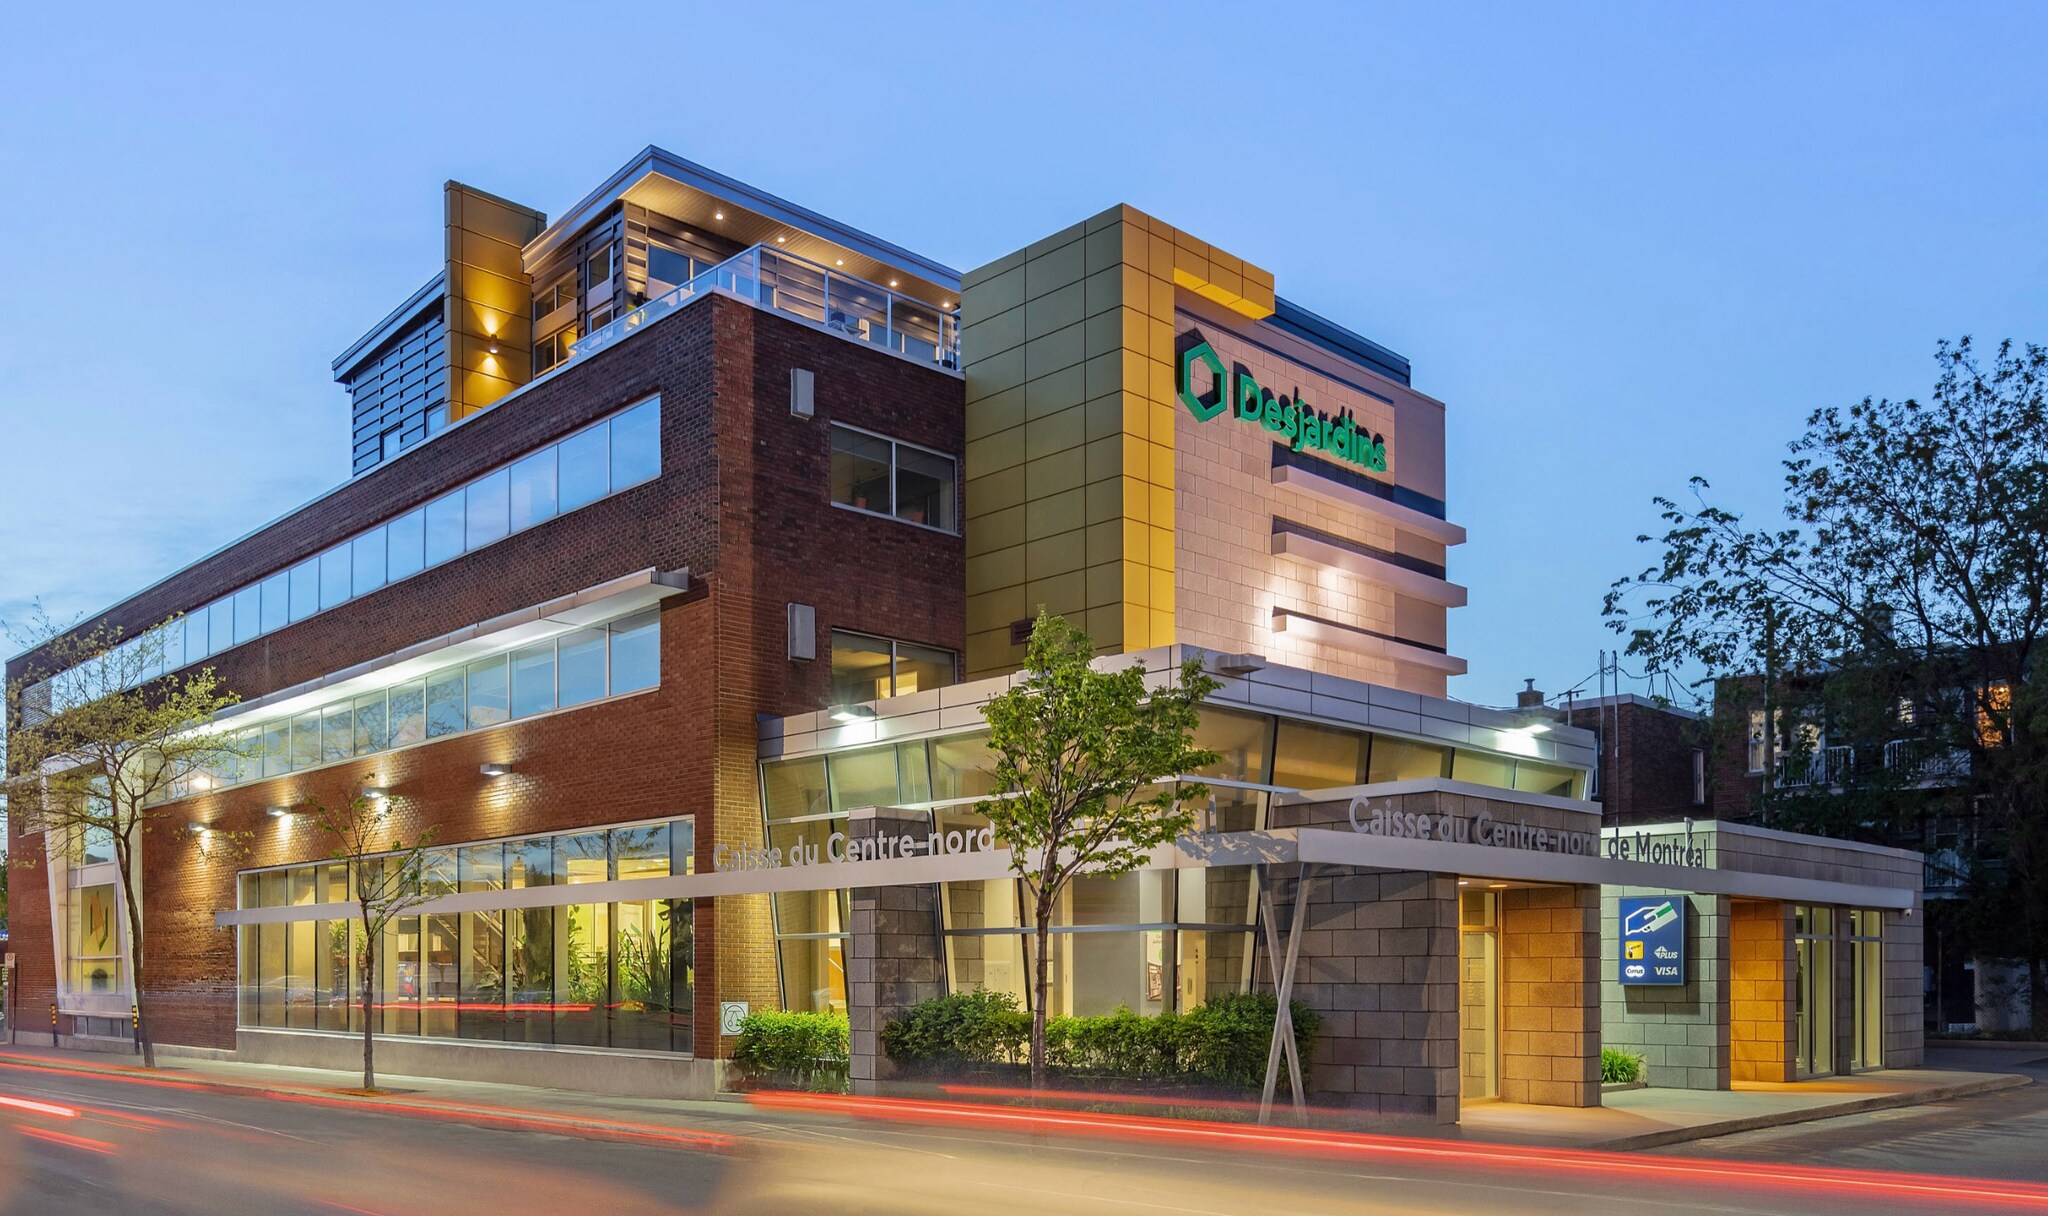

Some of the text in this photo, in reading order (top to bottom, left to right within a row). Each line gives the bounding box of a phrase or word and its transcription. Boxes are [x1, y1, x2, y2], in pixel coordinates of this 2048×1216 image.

[1240, 374, 1387, 472] Desjardins
[713, 819, 996, 873] Caisse du Centre-nord
[1348, 796, 1430, 840] Caisse
[1438, 805, 1469, 843] du
[1608, 827, 1630, 861] de
[1635, 831, 1708, 869] Montréal
[1655, 967, 1678, 975] VISA
[1660, 951, 1678, 959] PLUS
